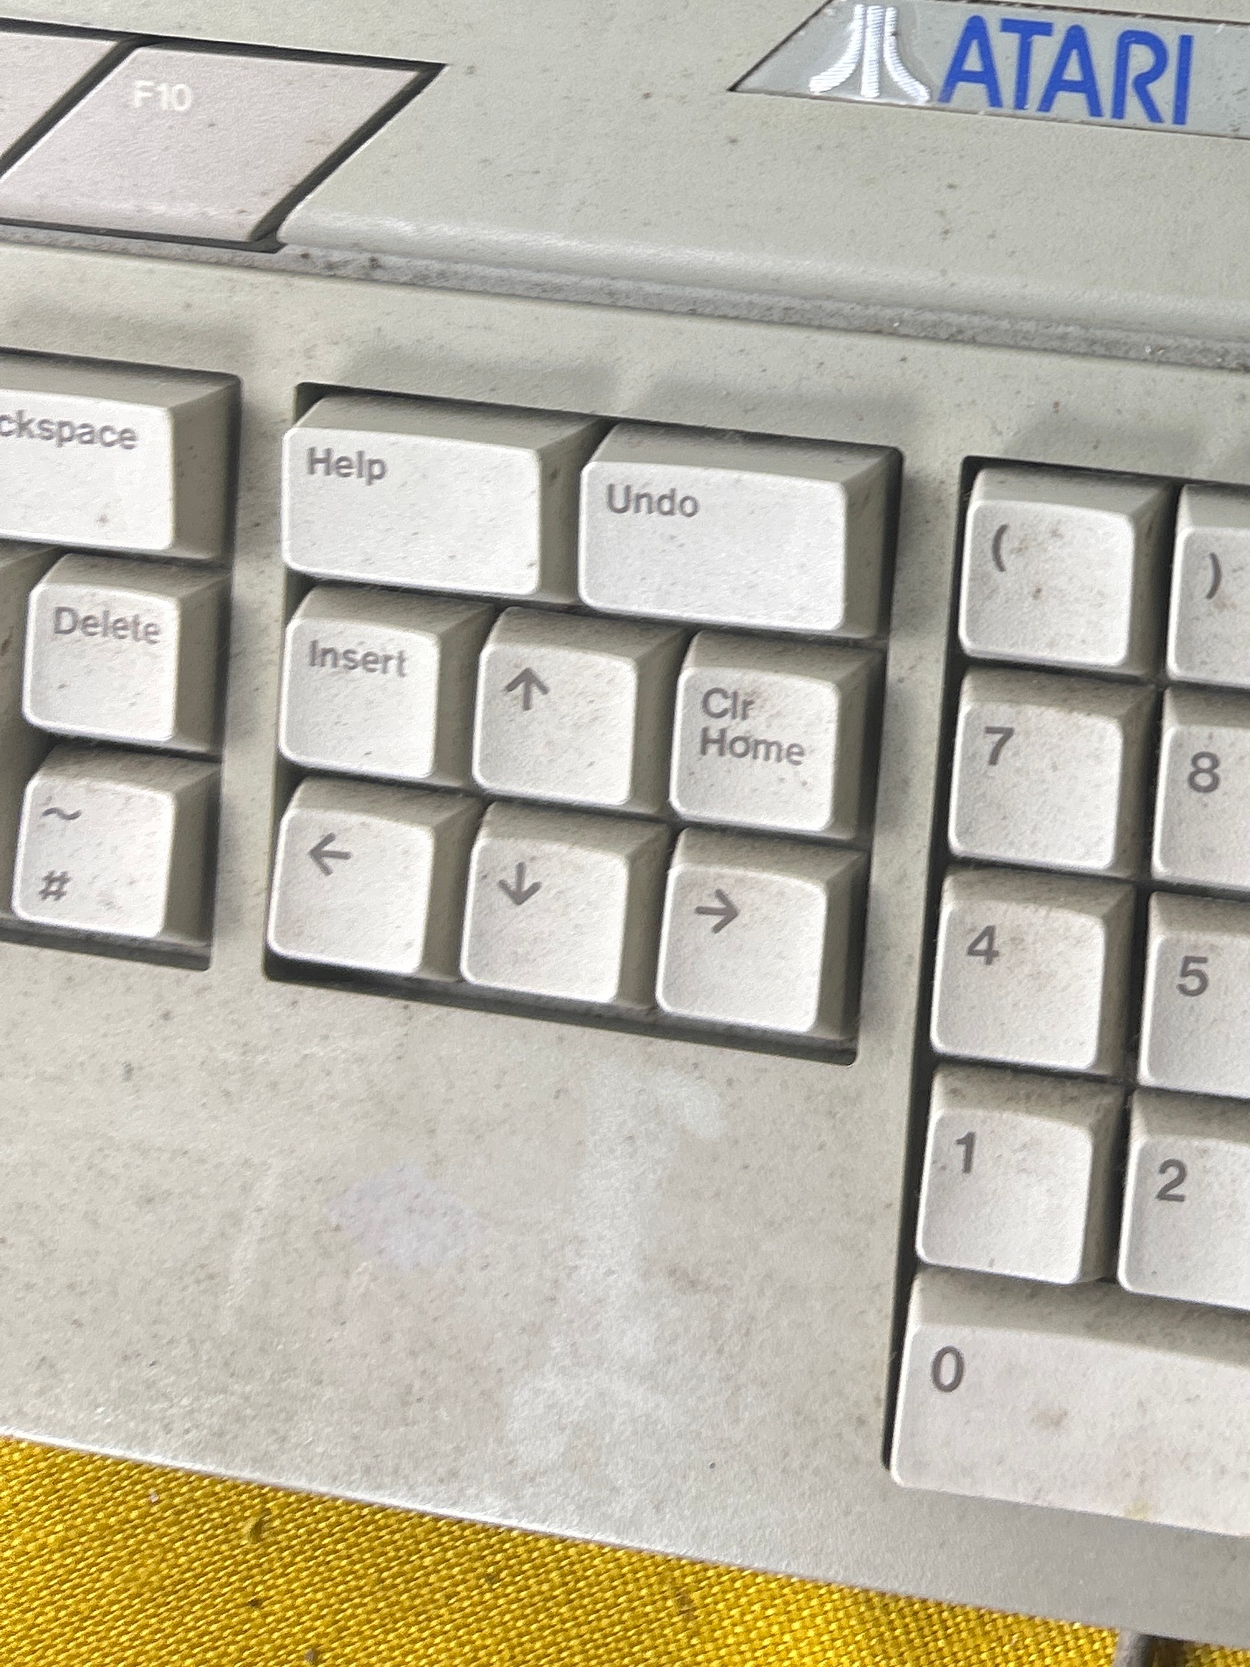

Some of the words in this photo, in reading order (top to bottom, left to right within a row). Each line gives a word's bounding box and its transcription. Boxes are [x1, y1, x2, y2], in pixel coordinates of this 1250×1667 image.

[937, 14, 1194, 126] ATARI
[132, 81, 194, 111] F10
[307, 447, 387, 486] Help
[606, 483, 699, 518] Undo
[49, 606, 159, 644] Delete
[306, 639, 405, 677] Insert
[701, 687, 755, 720] Clr
[697, 725, 804, 765] Home
[984, 726, 1014, 766] 7
[1187, 752, 1220, 794] 8
[38, 871, 70, 901] #
[967, 926, 999, 965] 4
[1177, 956, 1208, 997] 5
[956, 1132, 975, 1174] 1
[1156, 1159, 1187, 1202] 2
[931, 1346, 965, 1393] 0
